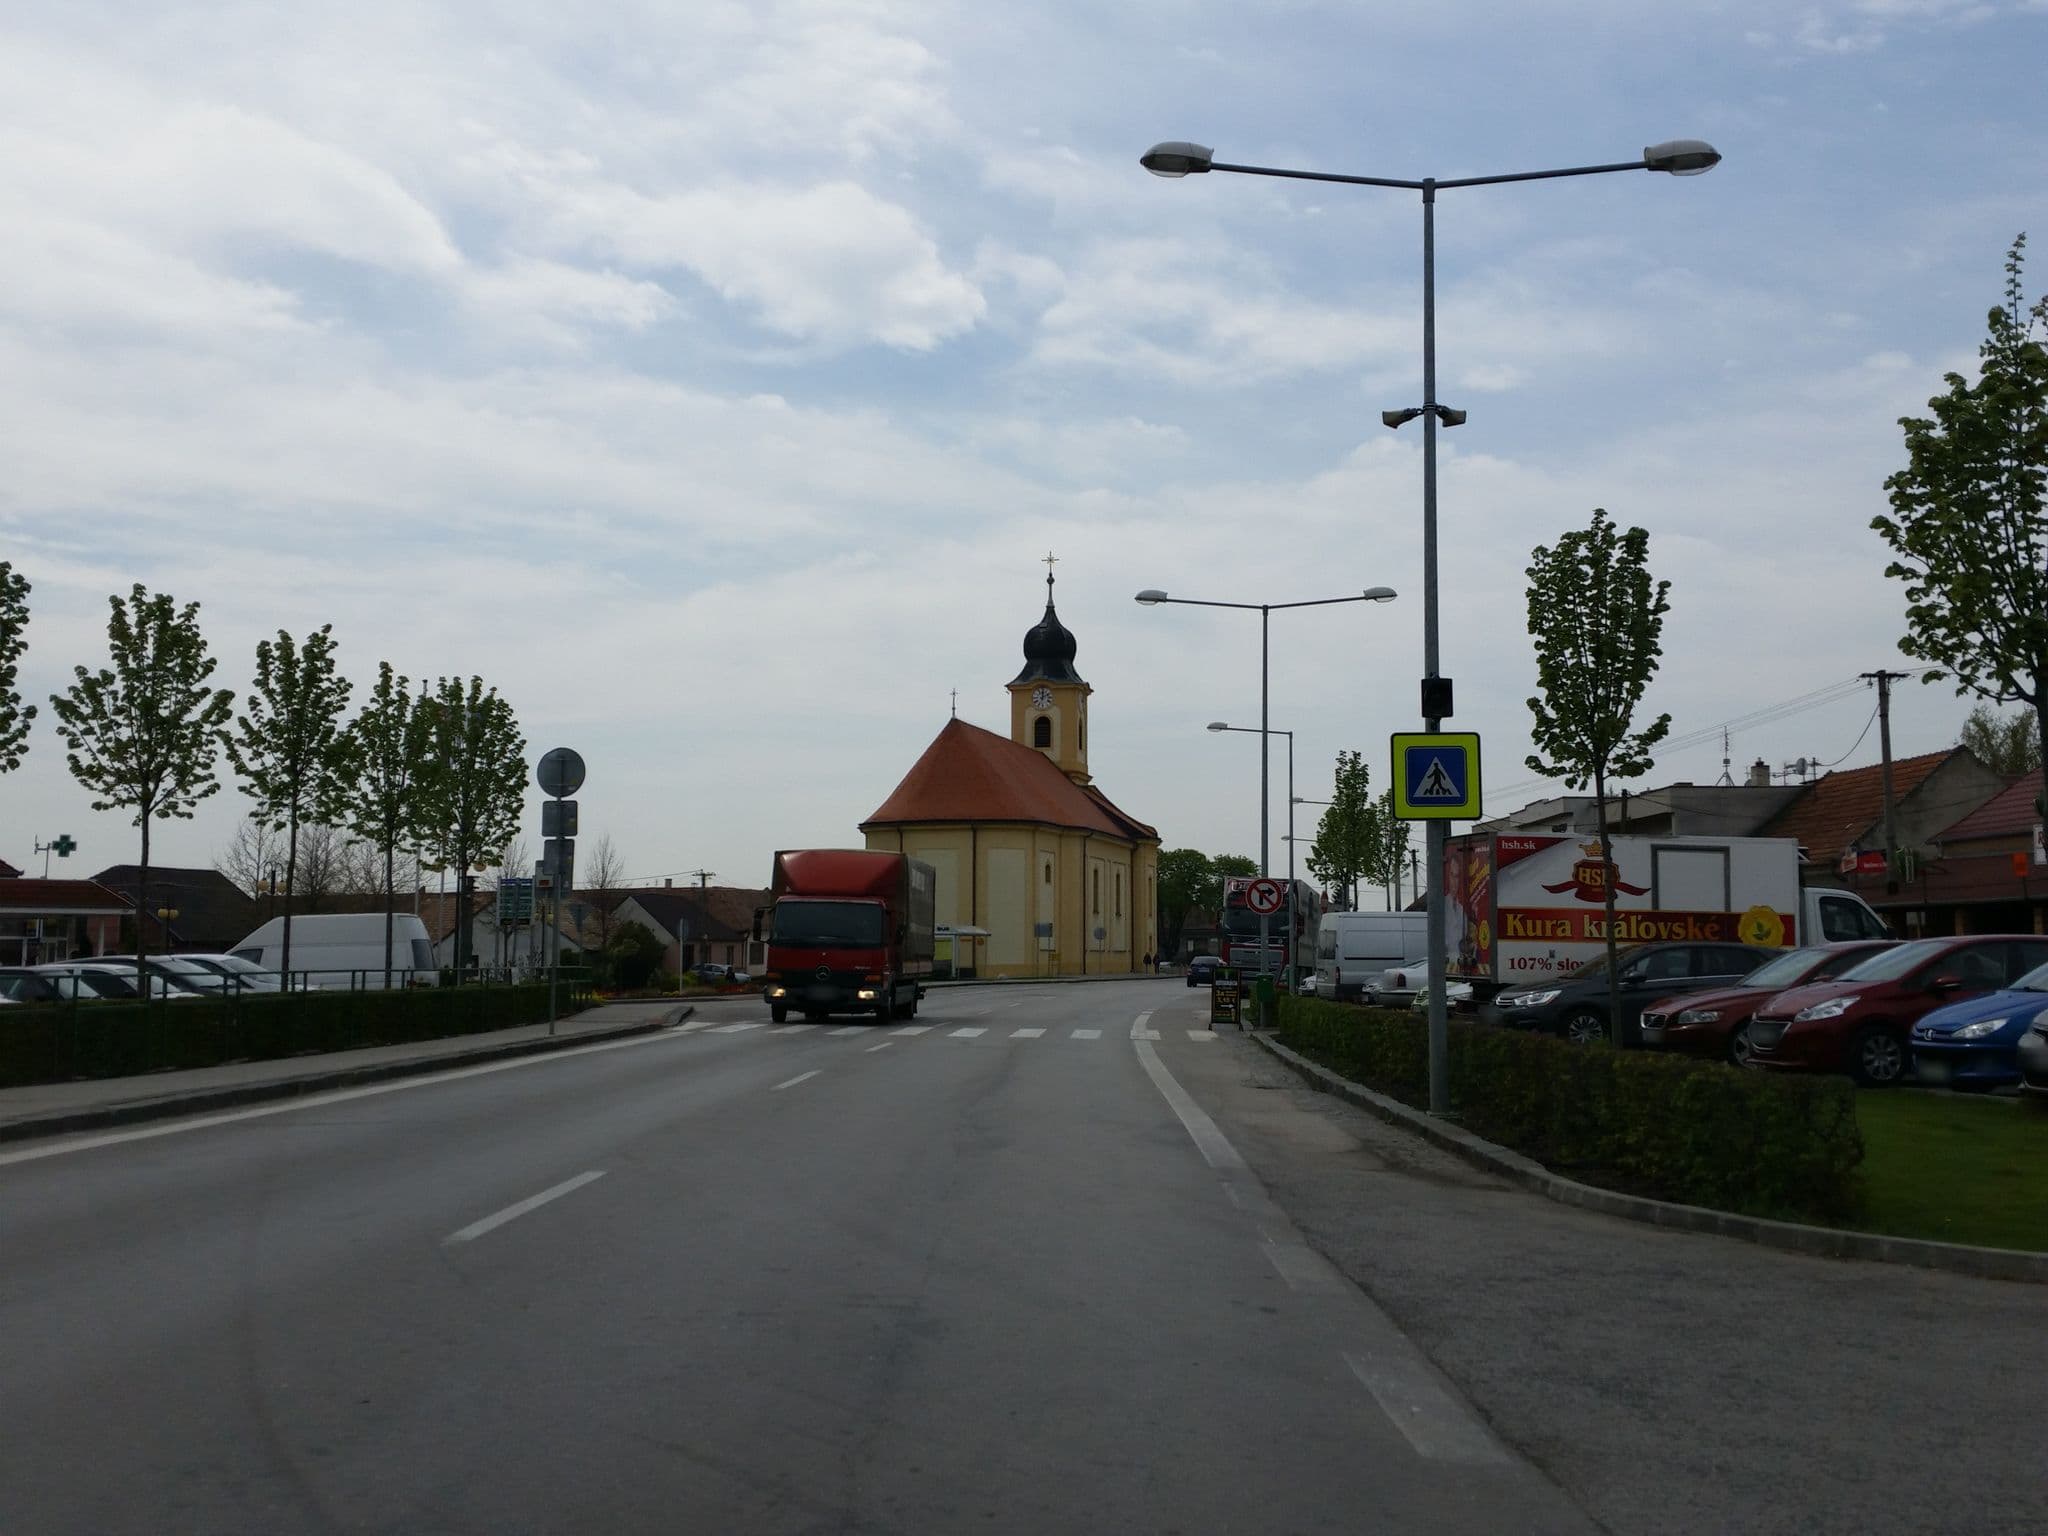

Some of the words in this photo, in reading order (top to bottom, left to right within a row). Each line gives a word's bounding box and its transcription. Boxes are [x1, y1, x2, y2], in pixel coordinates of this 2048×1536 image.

[1502, 840, 1536, 850] hsh.sk
[1506, 913, 1572, 937] Kura
[1508, 957, 1552, 971] 107%
[1557, 957, 1585, 971] slo
